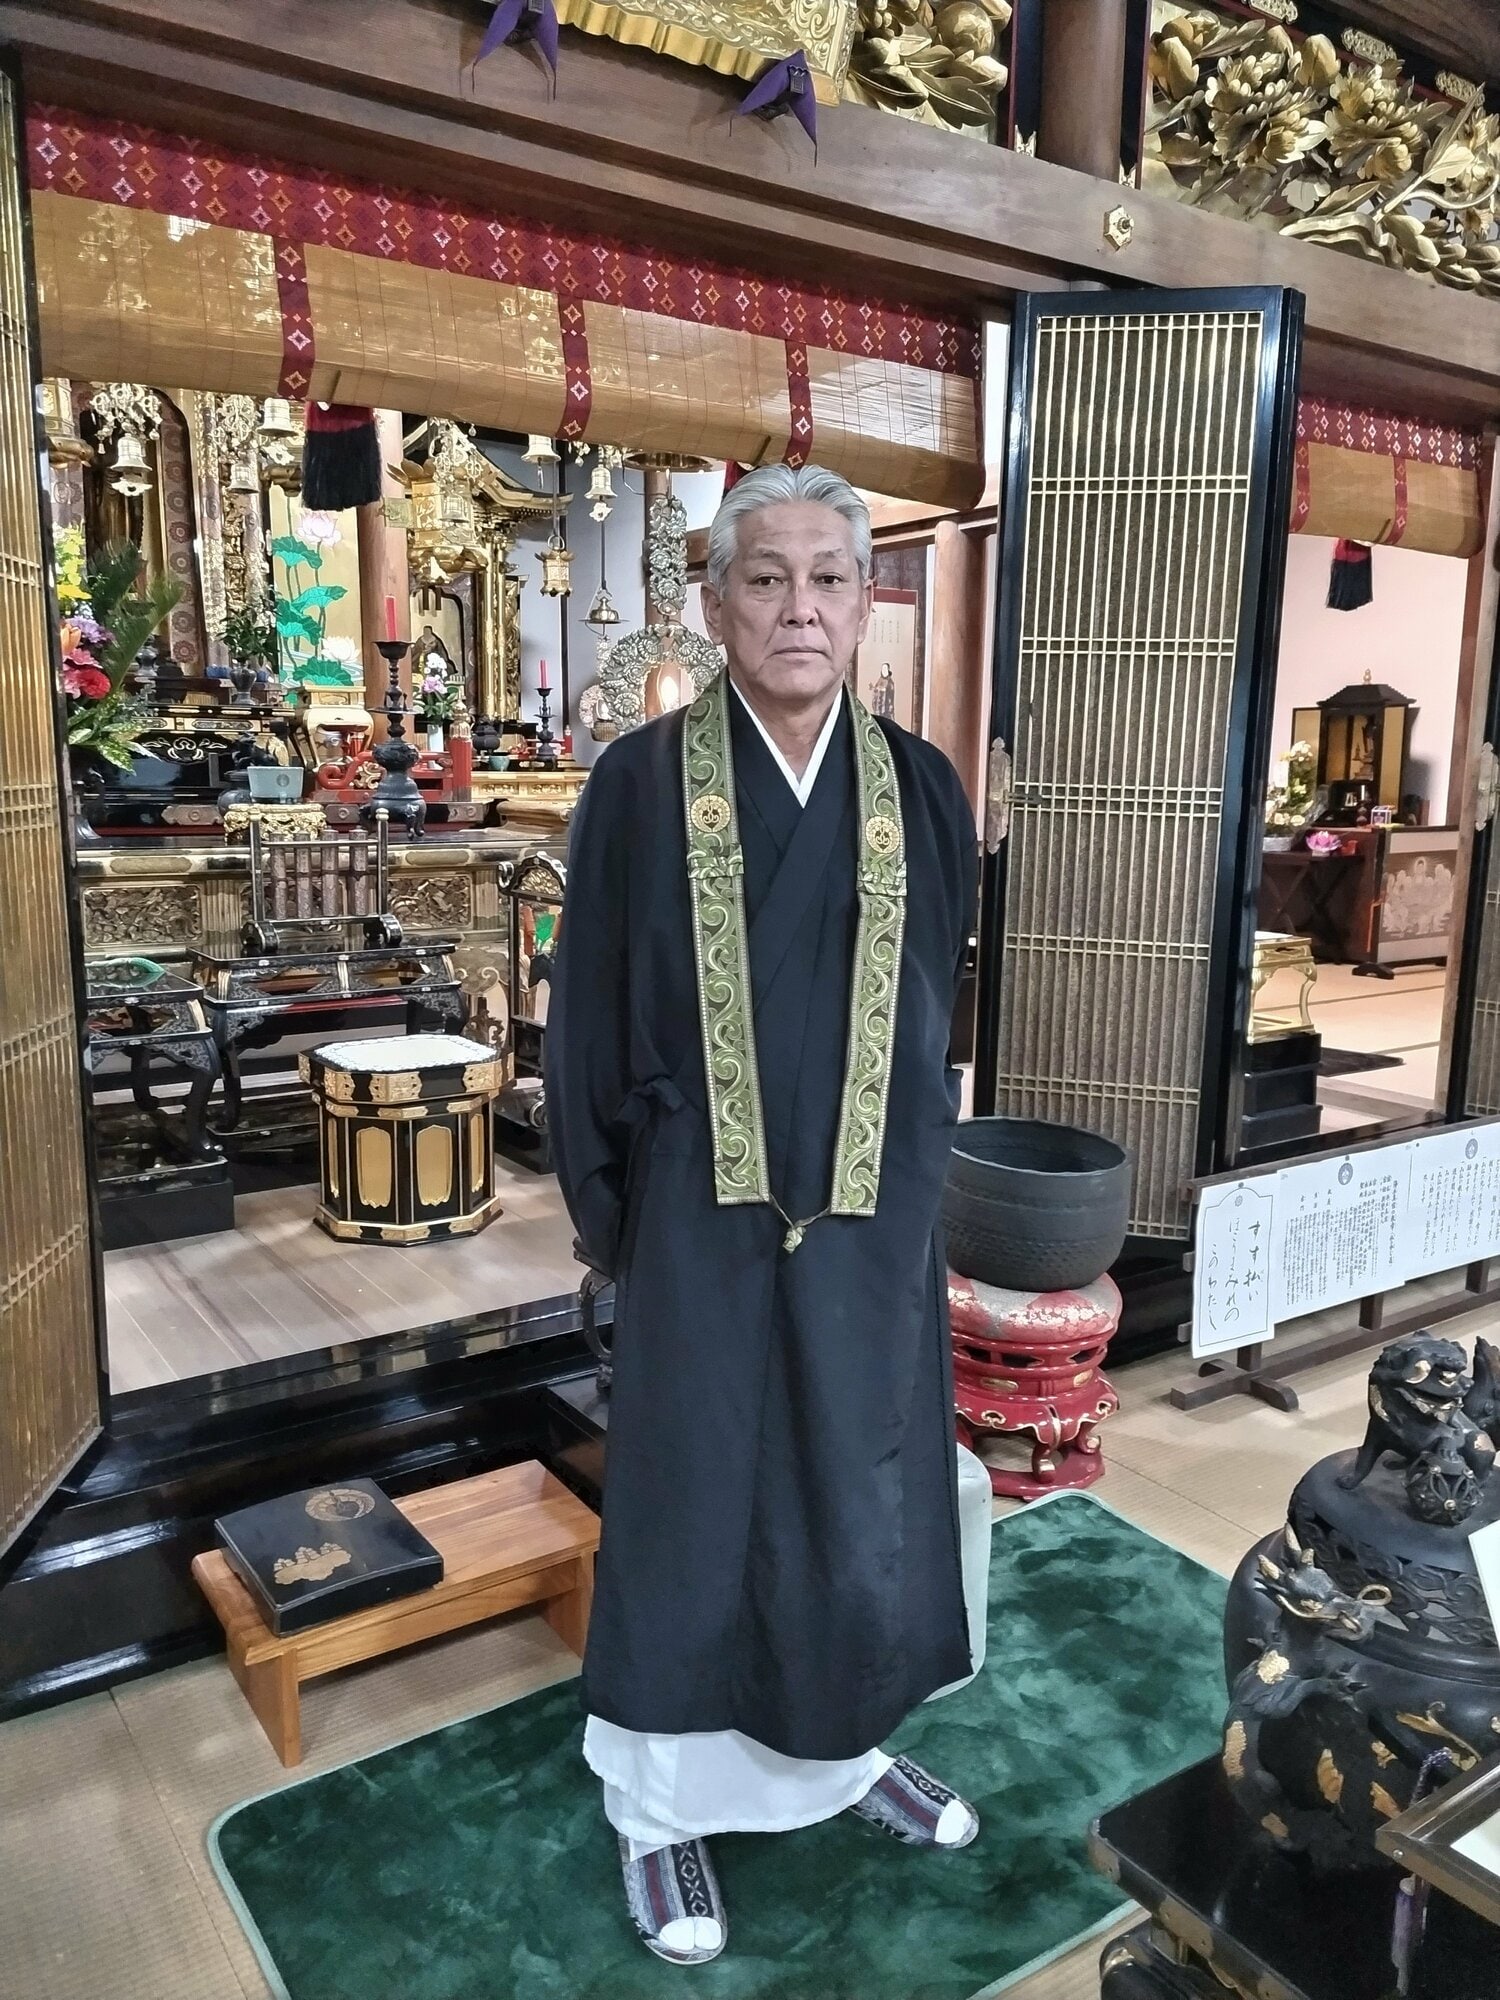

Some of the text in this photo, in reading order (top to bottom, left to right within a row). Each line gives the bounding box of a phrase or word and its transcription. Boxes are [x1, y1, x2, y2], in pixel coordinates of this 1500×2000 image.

[1207, 1243, 1219, 1331] このわたし
[1224, 1217, 1240, 1322] ほこりまみれの
[1243, 1220, 1261, 1302] すす払い
